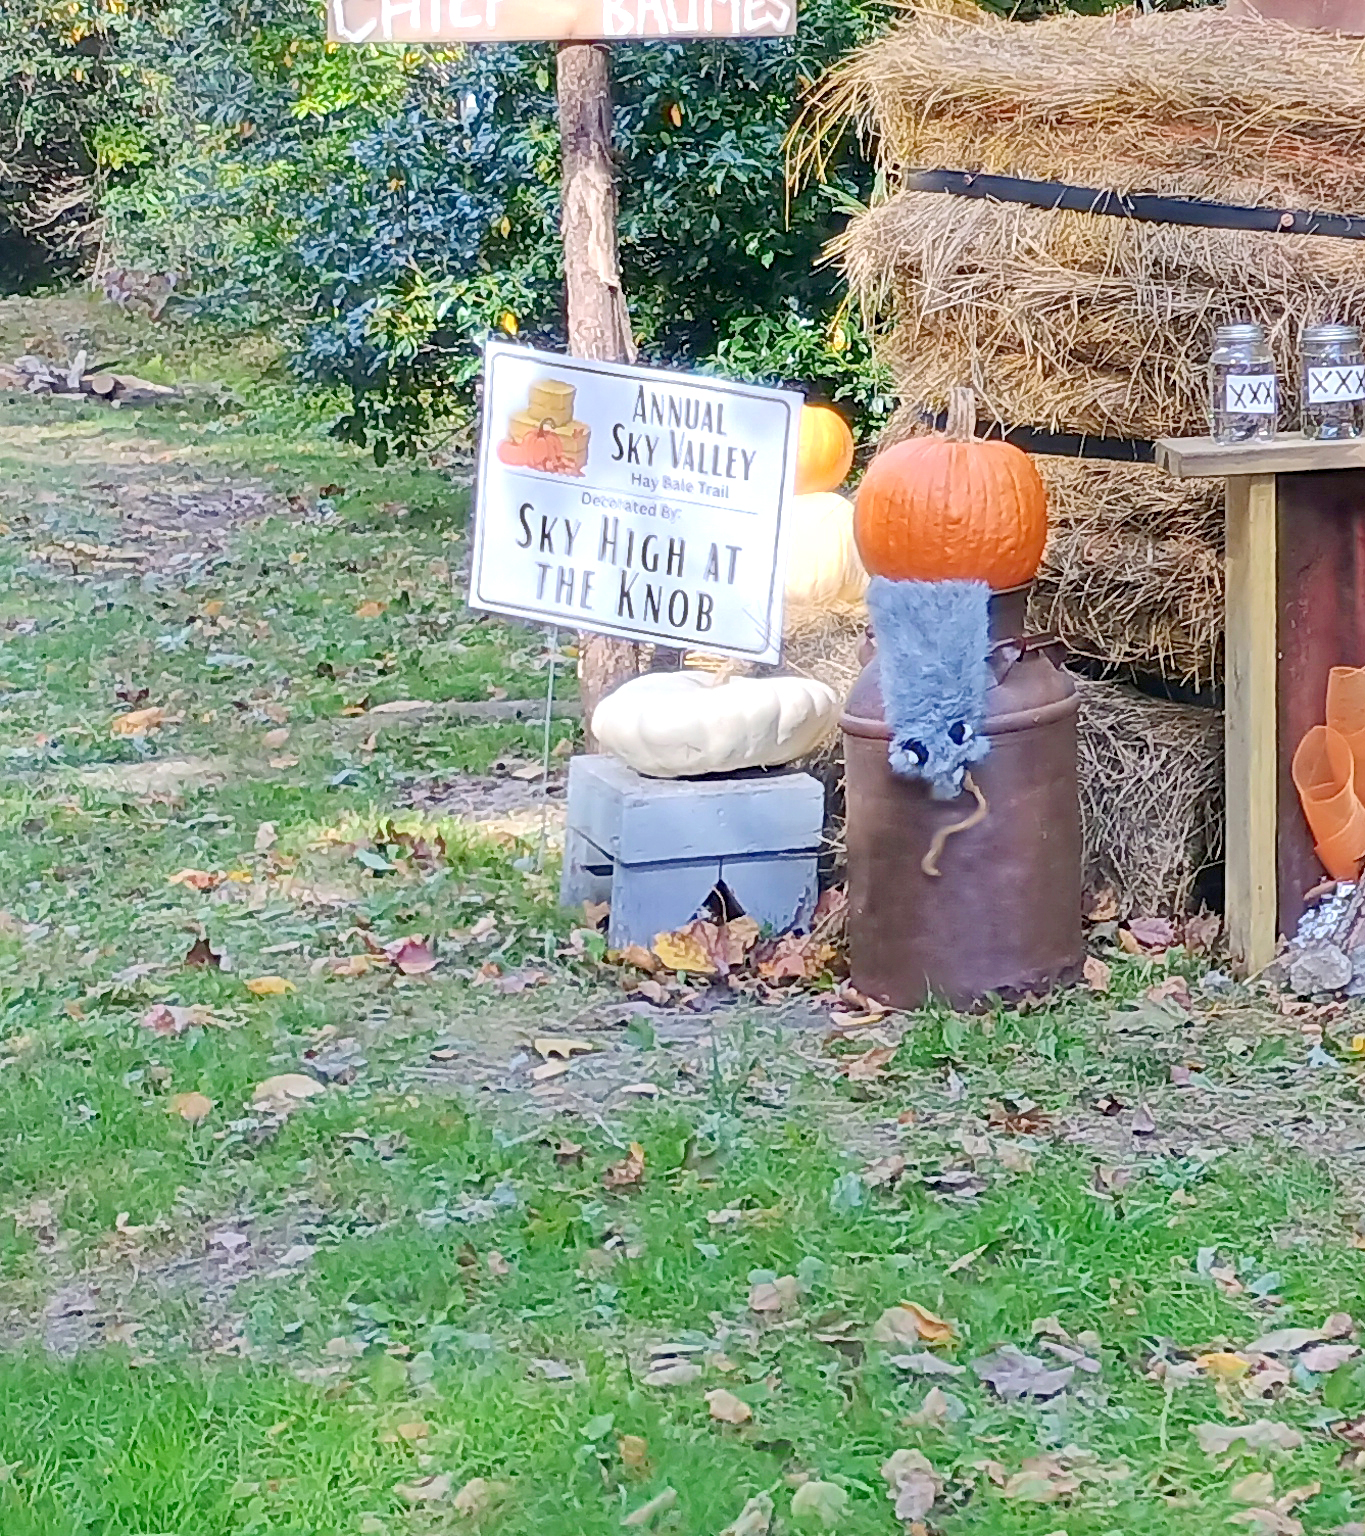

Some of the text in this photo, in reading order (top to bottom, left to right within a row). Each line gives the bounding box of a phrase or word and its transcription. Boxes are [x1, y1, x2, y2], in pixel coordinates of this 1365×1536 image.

[1229, 381, 1273, 409] XXX
[1311, 369, 1365, 395] XXX
[632, 384, 727, 436] ANNUAL
[611, 423, 757, 481] SKY VALLEY
[581, 491, 657, 517] Decorated
[631, 472, 729, 498] Hay Bale Trail
[516, 502, 743, 584] SKY HIGH AT
[535, 561, 715, 632] THE KNOB
